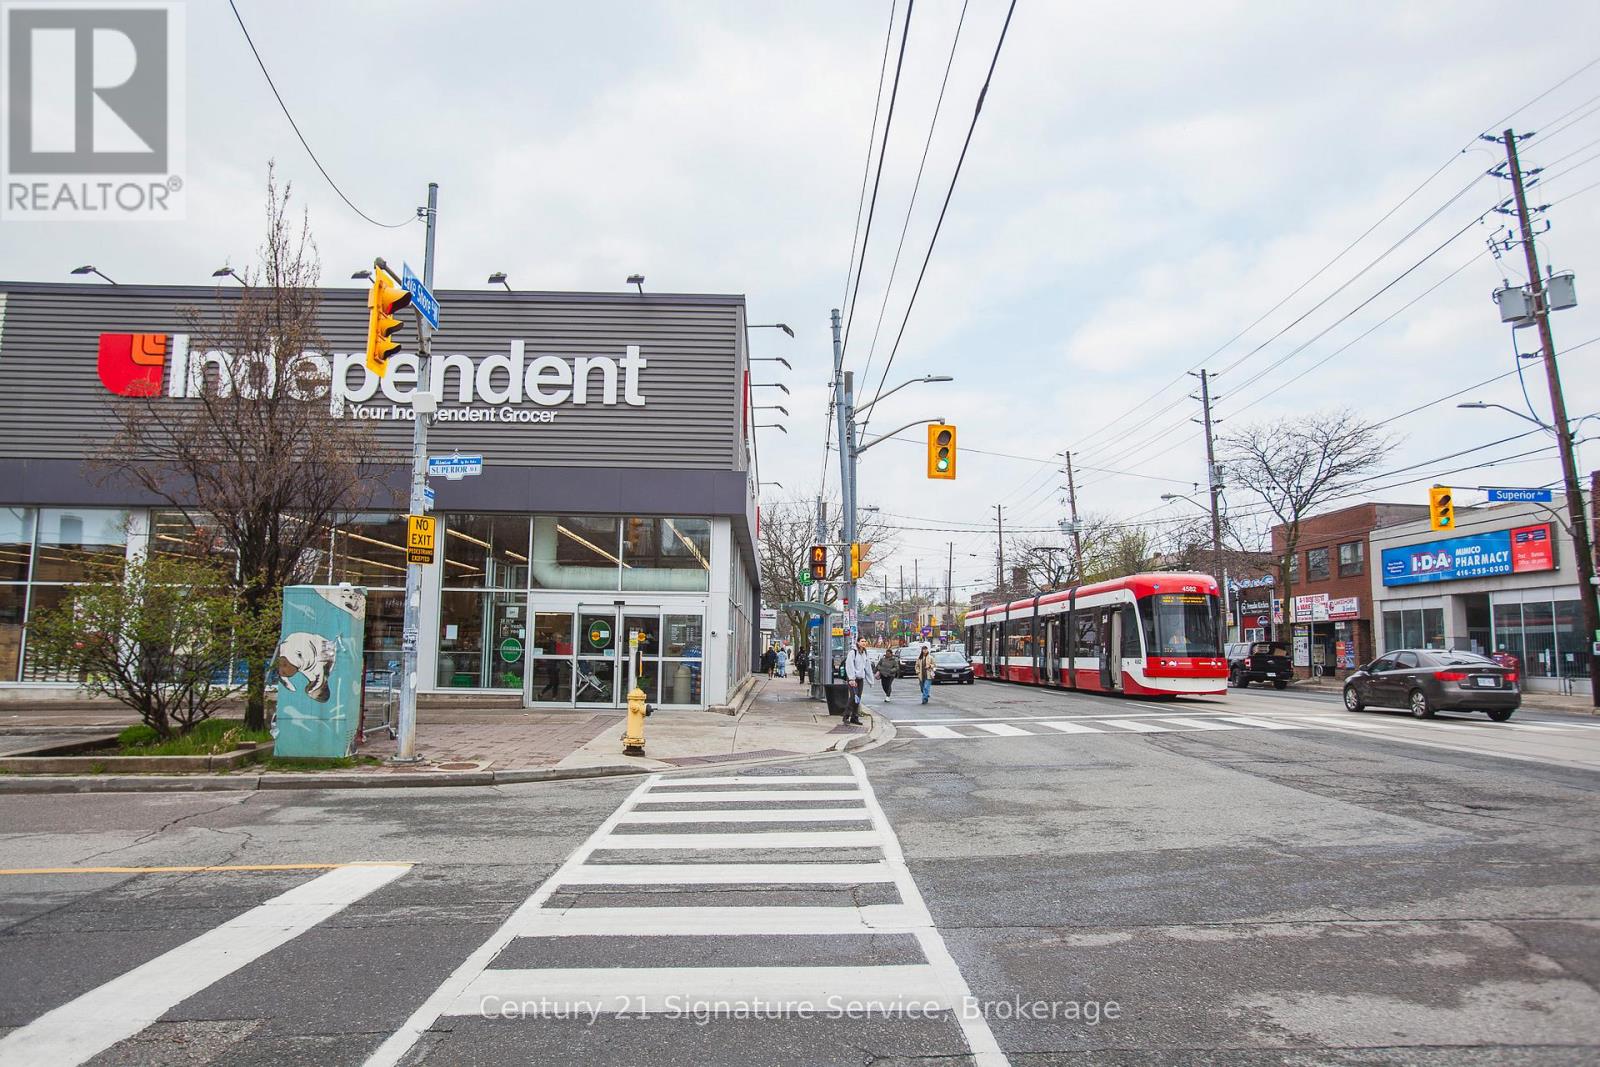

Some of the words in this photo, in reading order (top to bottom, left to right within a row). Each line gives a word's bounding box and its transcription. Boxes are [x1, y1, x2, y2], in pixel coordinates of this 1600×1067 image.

[417, 284, 430, 315] Shore
[350, 405, 387, 421] Your
[499, 406, 558, 422] Grocer
[1496, 490, 1536, 501] Superior
[415, 519, 429, 531] NO
[411, 533, 432, 546] EXIT
[1455, 550, 1509, 568] PHARMACY
[803, 573, 811, 581] P
[817, 566, 824, 577] 4
